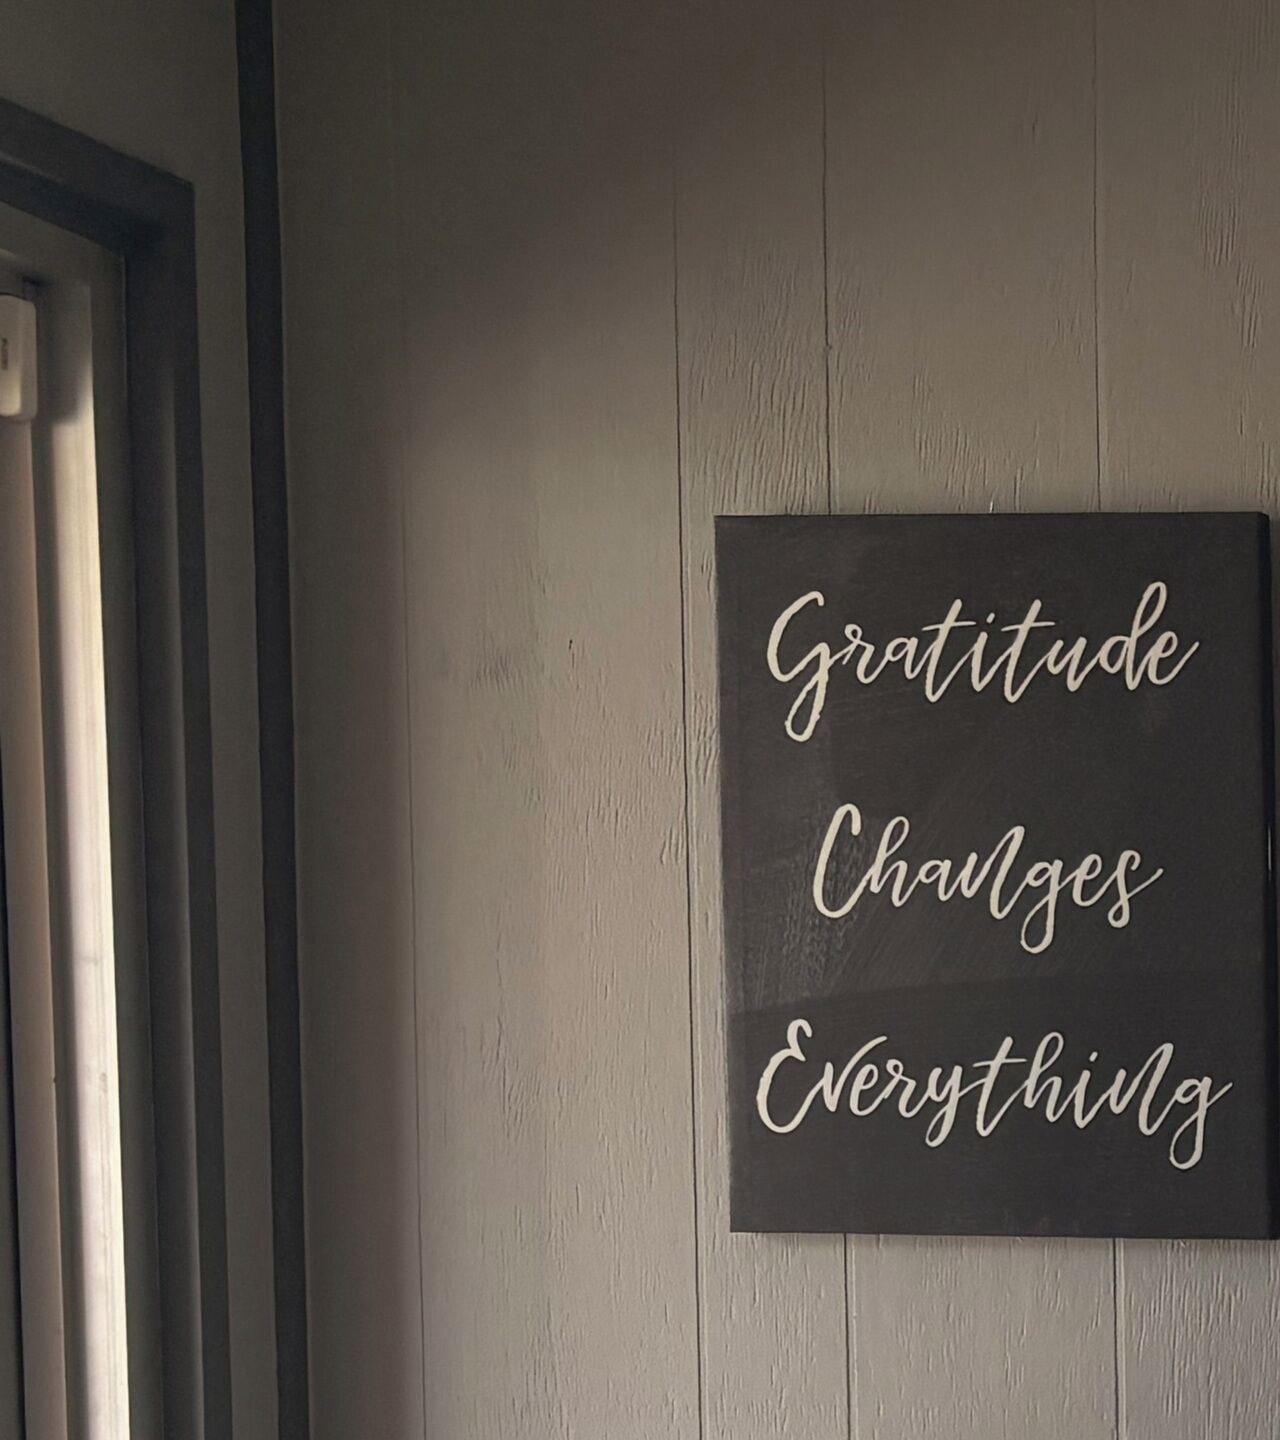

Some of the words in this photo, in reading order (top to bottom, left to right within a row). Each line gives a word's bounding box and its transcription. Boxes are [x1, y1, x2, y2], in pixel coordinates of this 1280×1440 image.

[766, 581, 1200, 742] Gratitude
[812, 803, 1164, 954] Changes
[755, 1018, 1234, 1170] Everything
